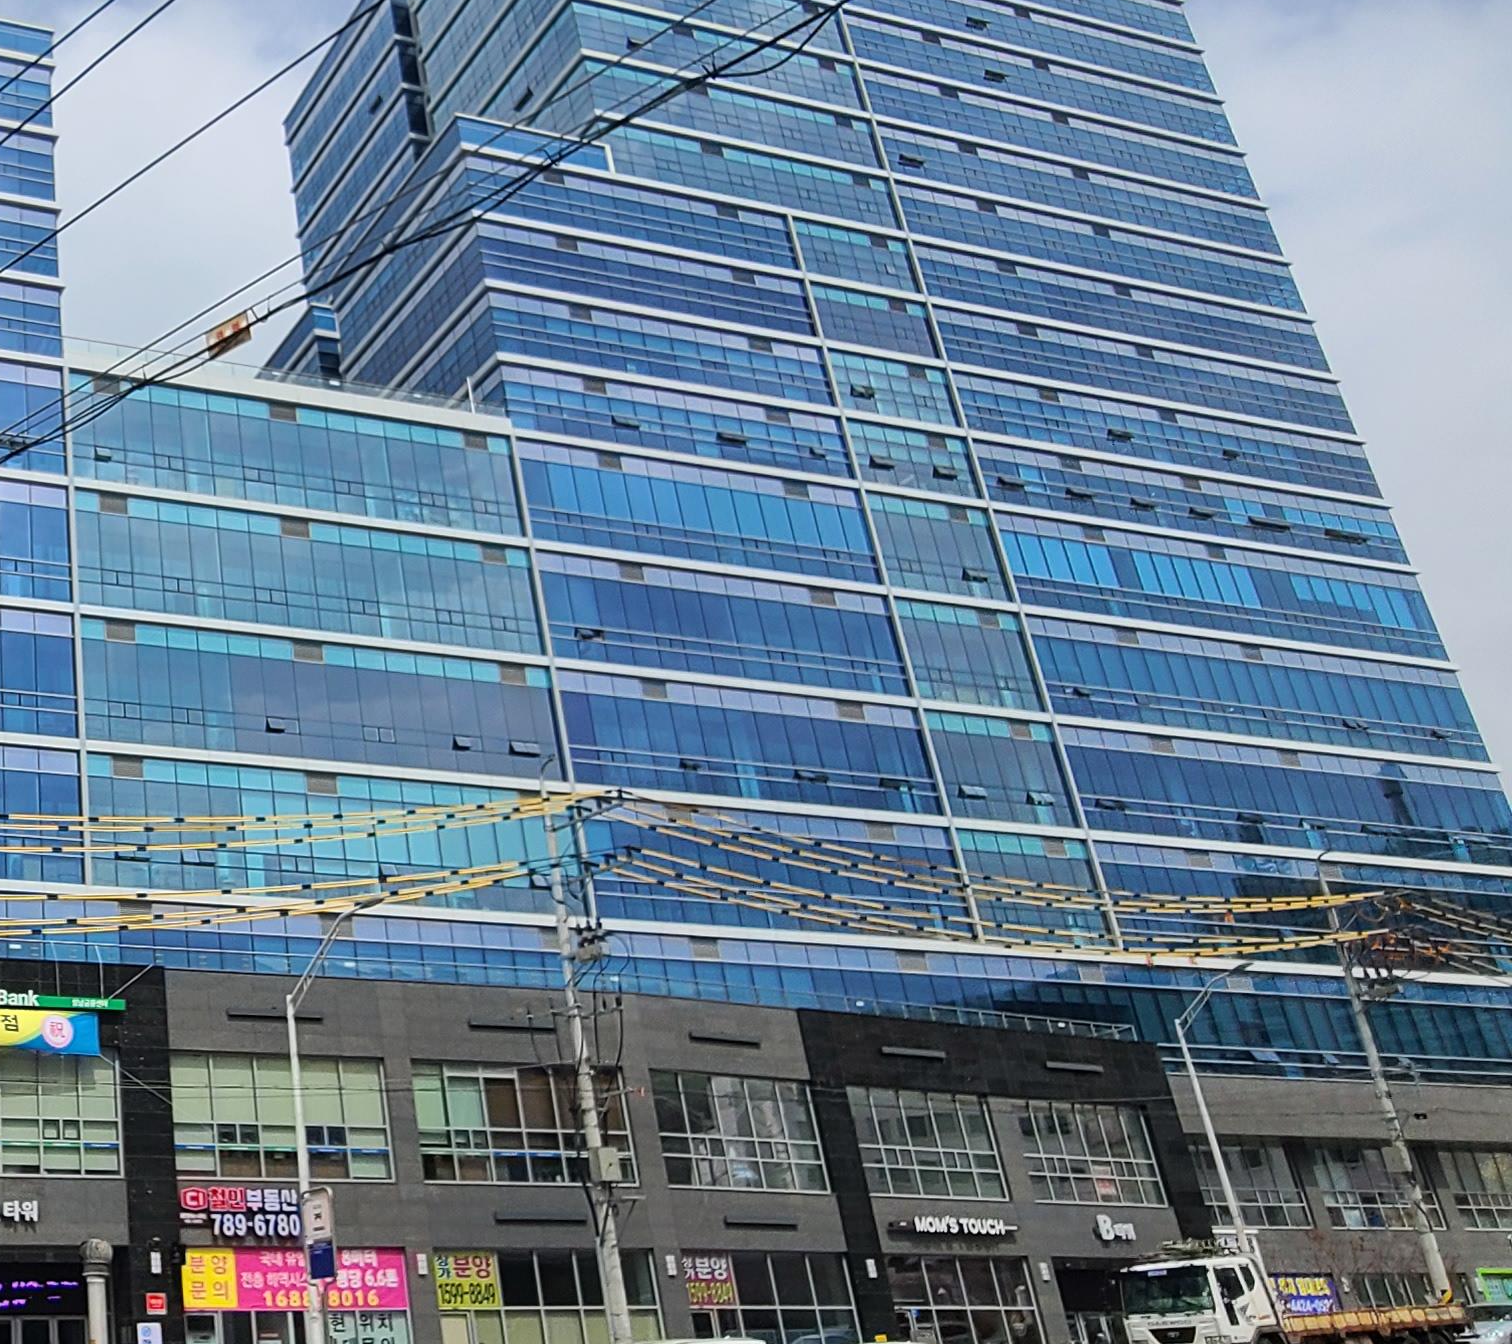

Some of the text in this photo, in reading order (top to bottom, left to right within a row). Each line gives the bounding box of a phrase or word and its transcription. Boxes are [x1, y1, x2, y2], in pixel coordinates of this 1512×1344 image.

[209, 1213, 302, 1237] 789-6780
[913, 1215, 1006, 1236] MOM'S TOUCH
[453, 1255, 492, 1280] 분양
[695, 1256, 728, 1281] 분양
[438, 1282, 496, 1305] 1599-8849
